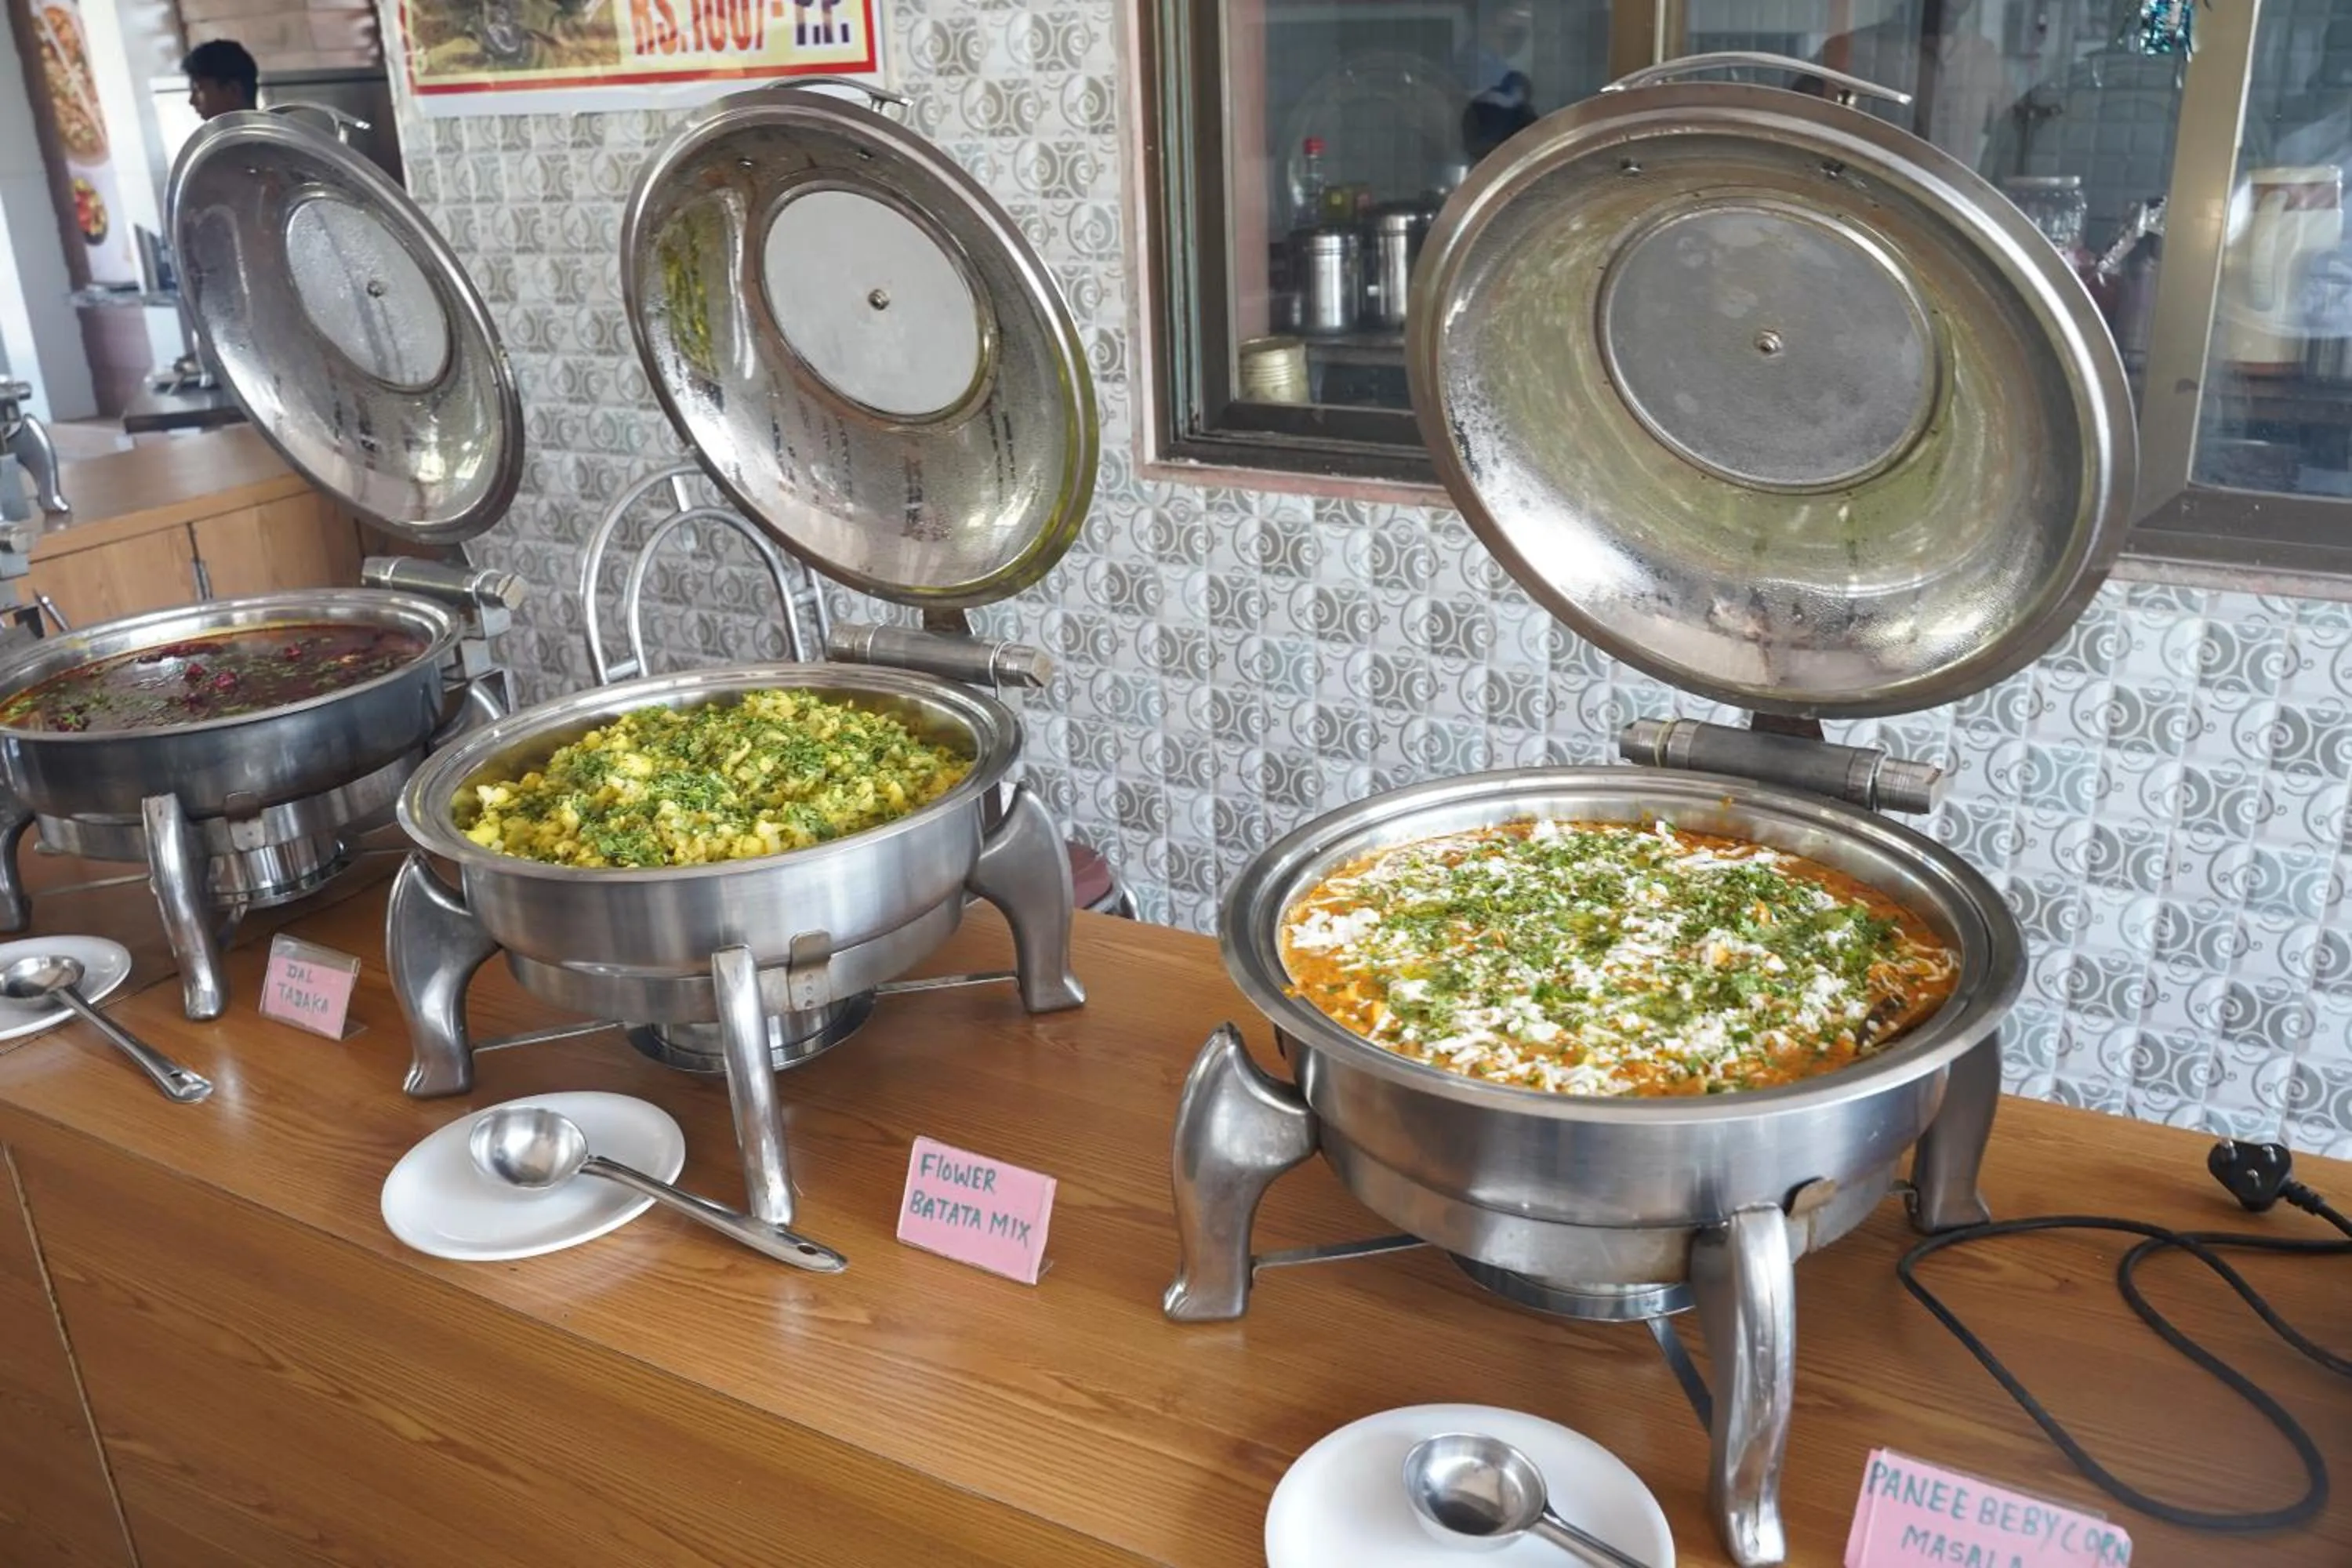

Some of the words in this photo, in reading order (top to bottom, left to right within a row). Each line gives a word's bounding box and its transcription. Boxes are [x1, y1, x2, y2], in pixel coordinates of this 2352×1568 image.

[286, 964, 314, 983] DAL
[910, 1189, 982, 1229] BATATA
[989, 1211, 1032, 1248] MIX
[1867, 1460, 1969, 1519] PANEE
